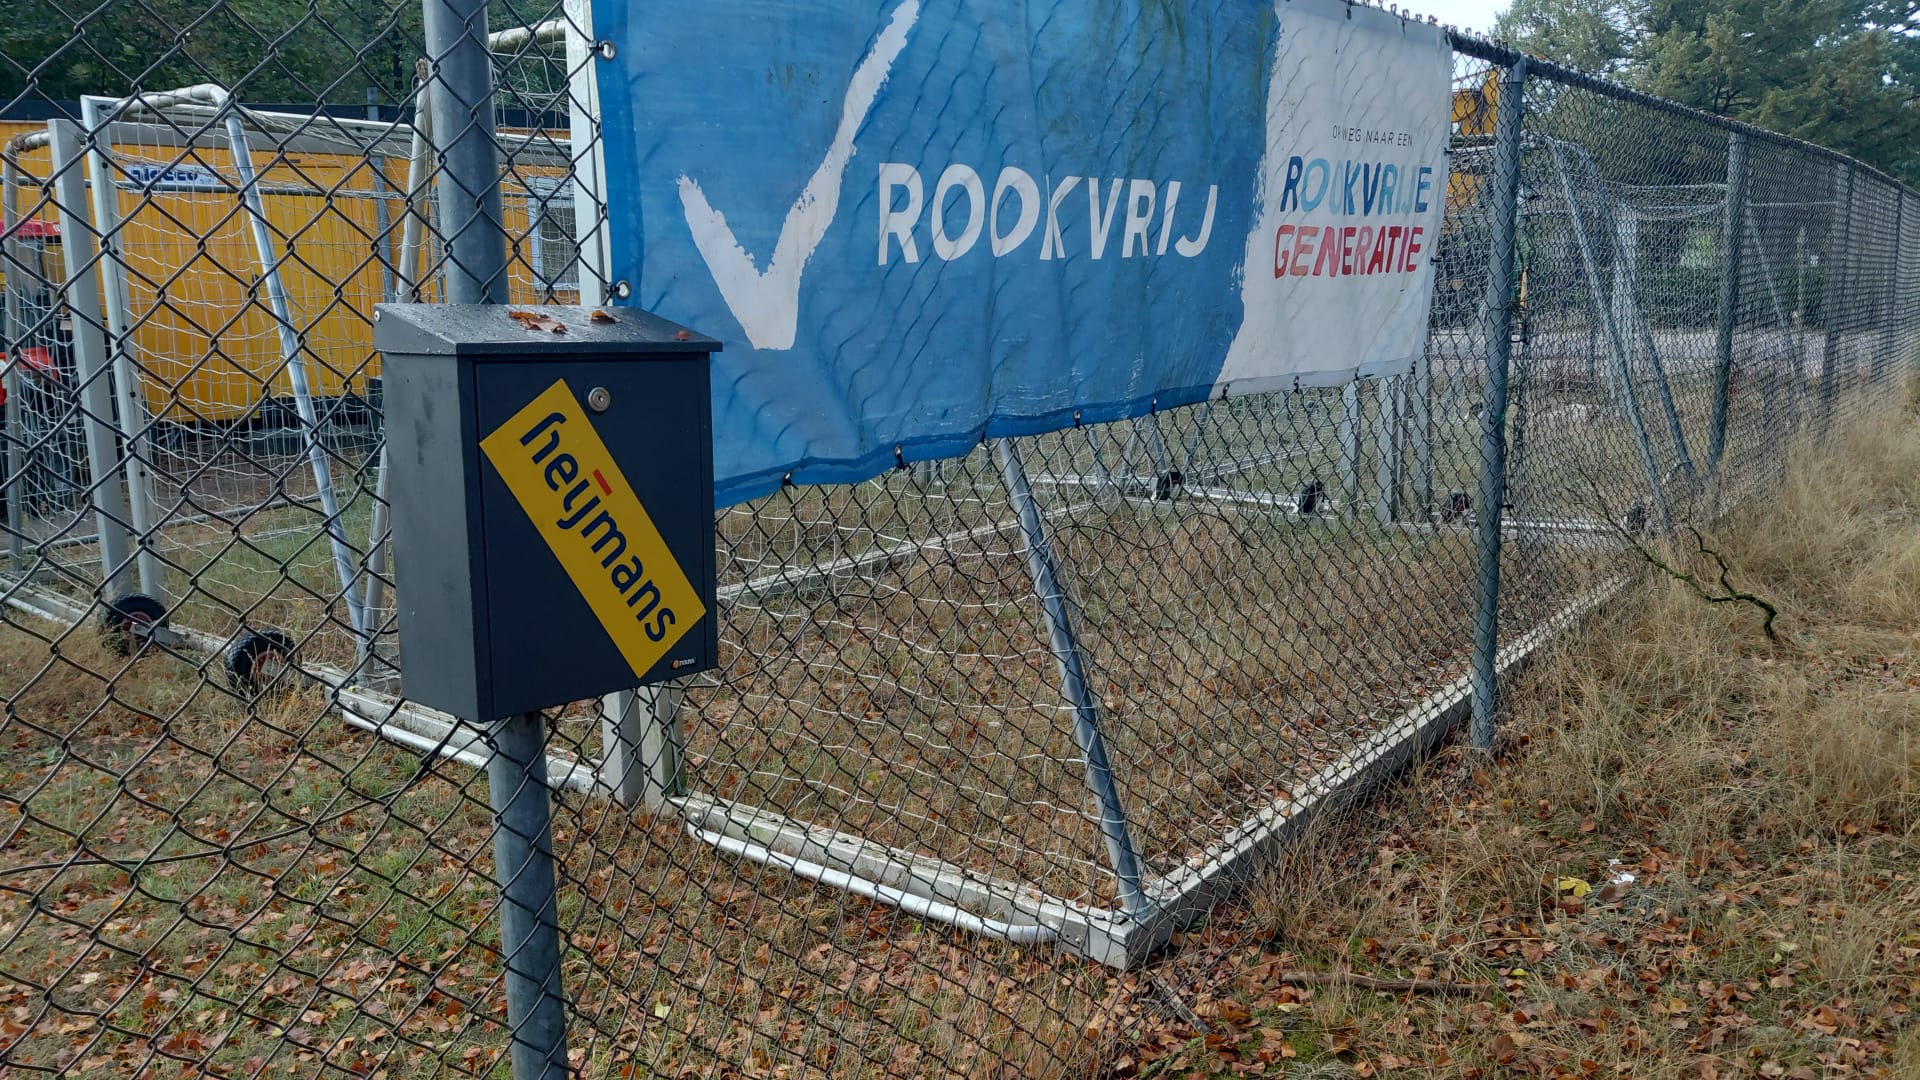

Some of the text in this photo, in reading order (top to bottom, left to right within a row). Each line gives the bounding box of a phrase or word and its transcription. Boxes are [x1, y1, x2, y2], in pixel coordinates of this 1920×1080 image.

[1342, 127, 1362, 142] WEG
[1365, 130, 1394, 144] NAAR
[1397, 133, 1413, 147] EEN
[878, 162, 1218, 265] ROOKVRIJ
[1280, 156, 1432, 217] ROOKVRIJE
[1274, 224, 1423, 279] GENERATIE
[519, 412, 676, 642] heijmans
